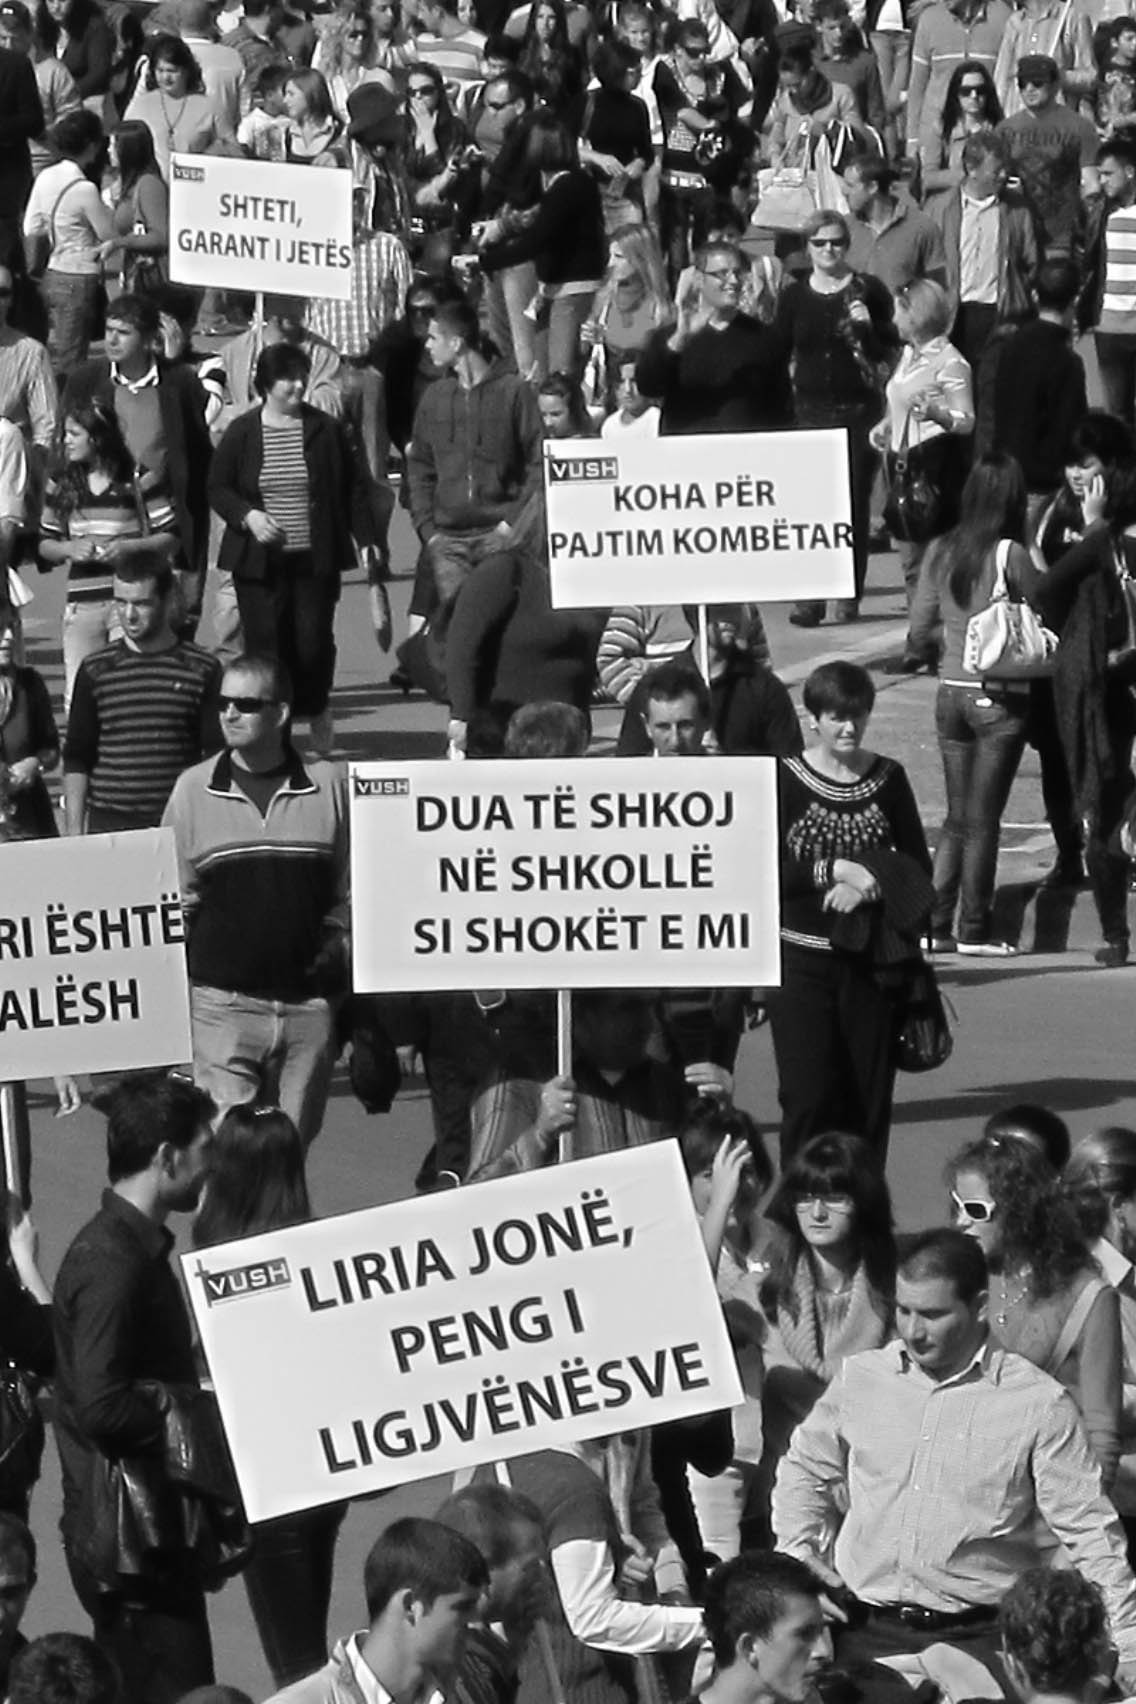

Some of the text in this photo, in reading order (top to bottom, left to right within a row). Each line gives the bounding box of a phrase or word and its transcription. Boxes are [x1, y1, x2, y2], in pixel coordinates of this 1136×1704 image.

[219, 193, 303, 228] SHTETI,
[177, 229, 351, 269] GARANT I JETËS
[552, 459, 618, 479] VUSH
[614, 475, 775, 512] KOHA PËR
[550, 518, 854, 559] PAJTIM KOMBËTAR
[357, 780, 409, 795] VUSH
[416, 785, 734, 832] DUA TË SHKOJ
[439, 844, 714, 893] NË SHKOLLË
[47, 893, 186, 956] ËSHTË
[413, 907, 749, 954] SI SHOKËT E MI
[301, 1187, 634, 1313] LIRIA JONË,
[208, 1260, 290, 1297] VUSH
[390, 1288, 586, 1375] PENG I
[318, 1342, 711, 1475] LIGJVËNËSVE
